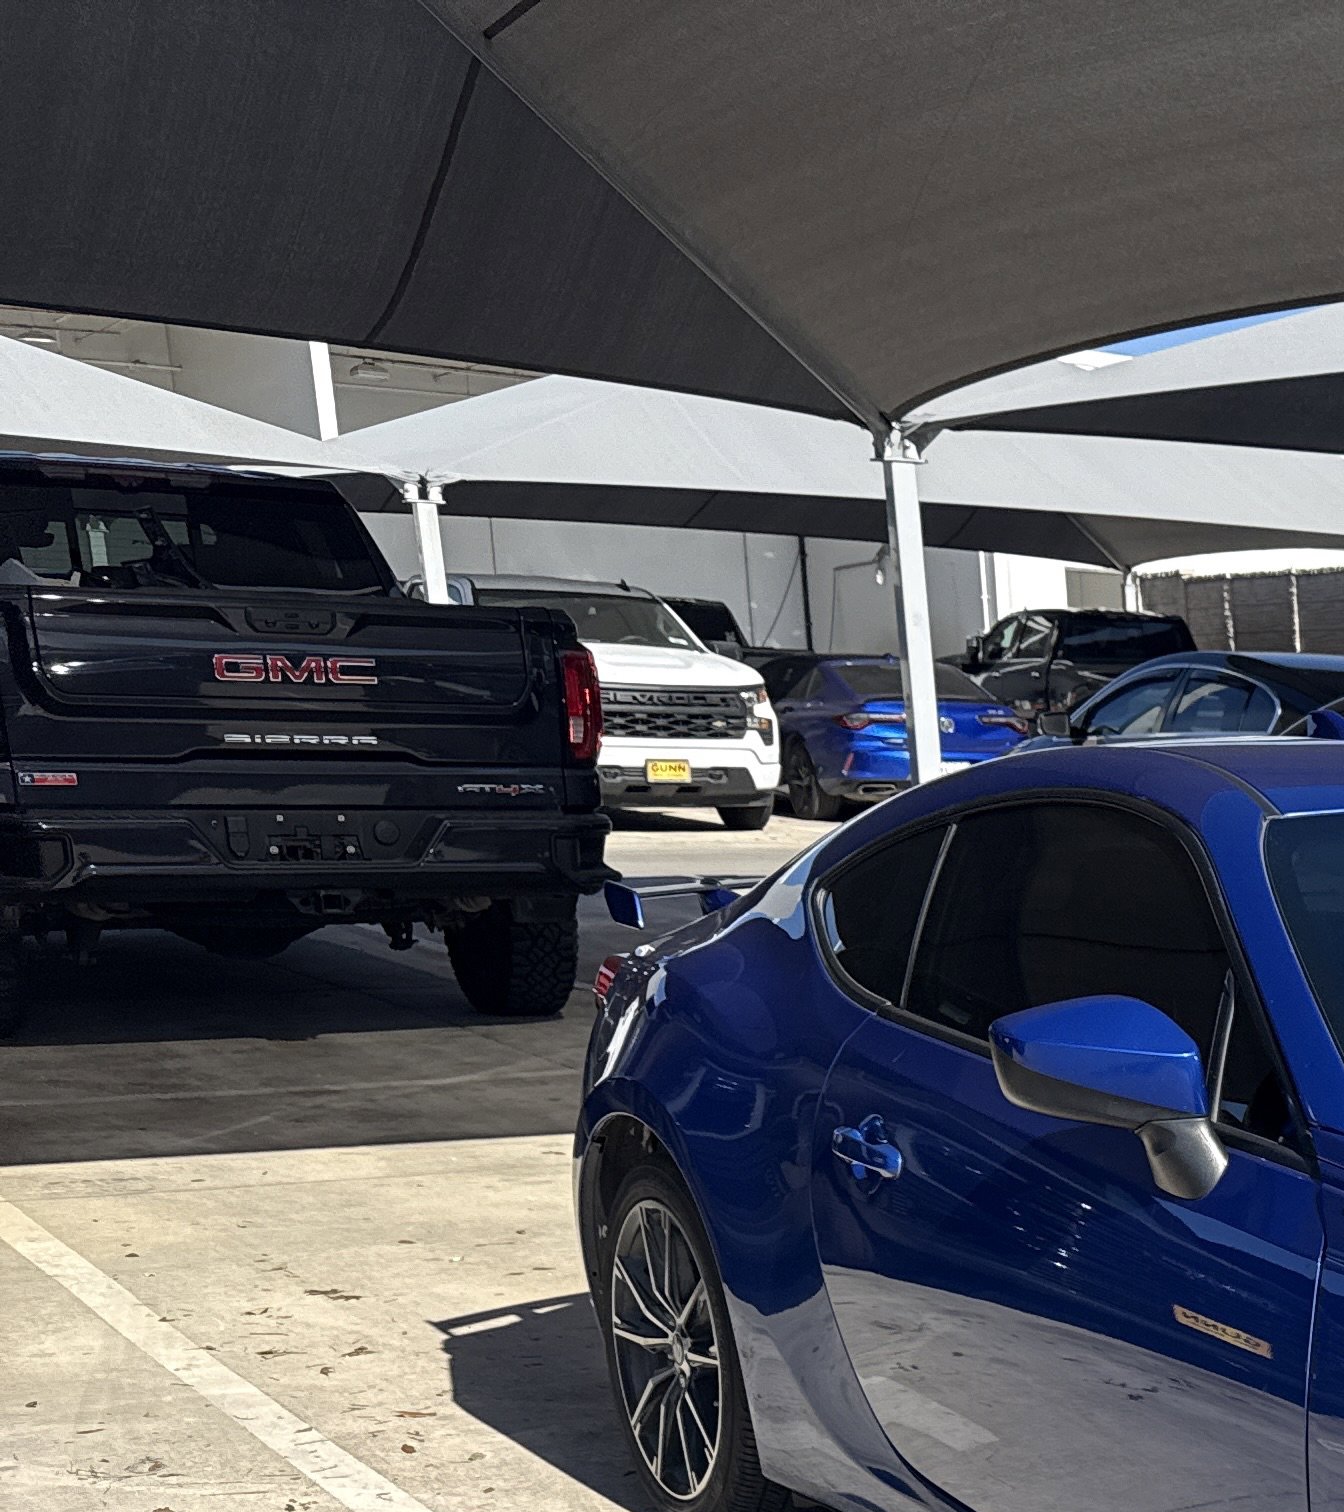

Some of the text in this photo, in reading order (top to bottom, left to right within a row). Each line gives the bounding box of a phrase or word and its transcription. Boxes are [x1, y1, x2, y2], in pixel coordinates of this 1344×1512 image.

[213, 653, 378, 684] GMC
[223, 734, 378, 744] SIERRA
[651, 763, 686, 773] GUNN
